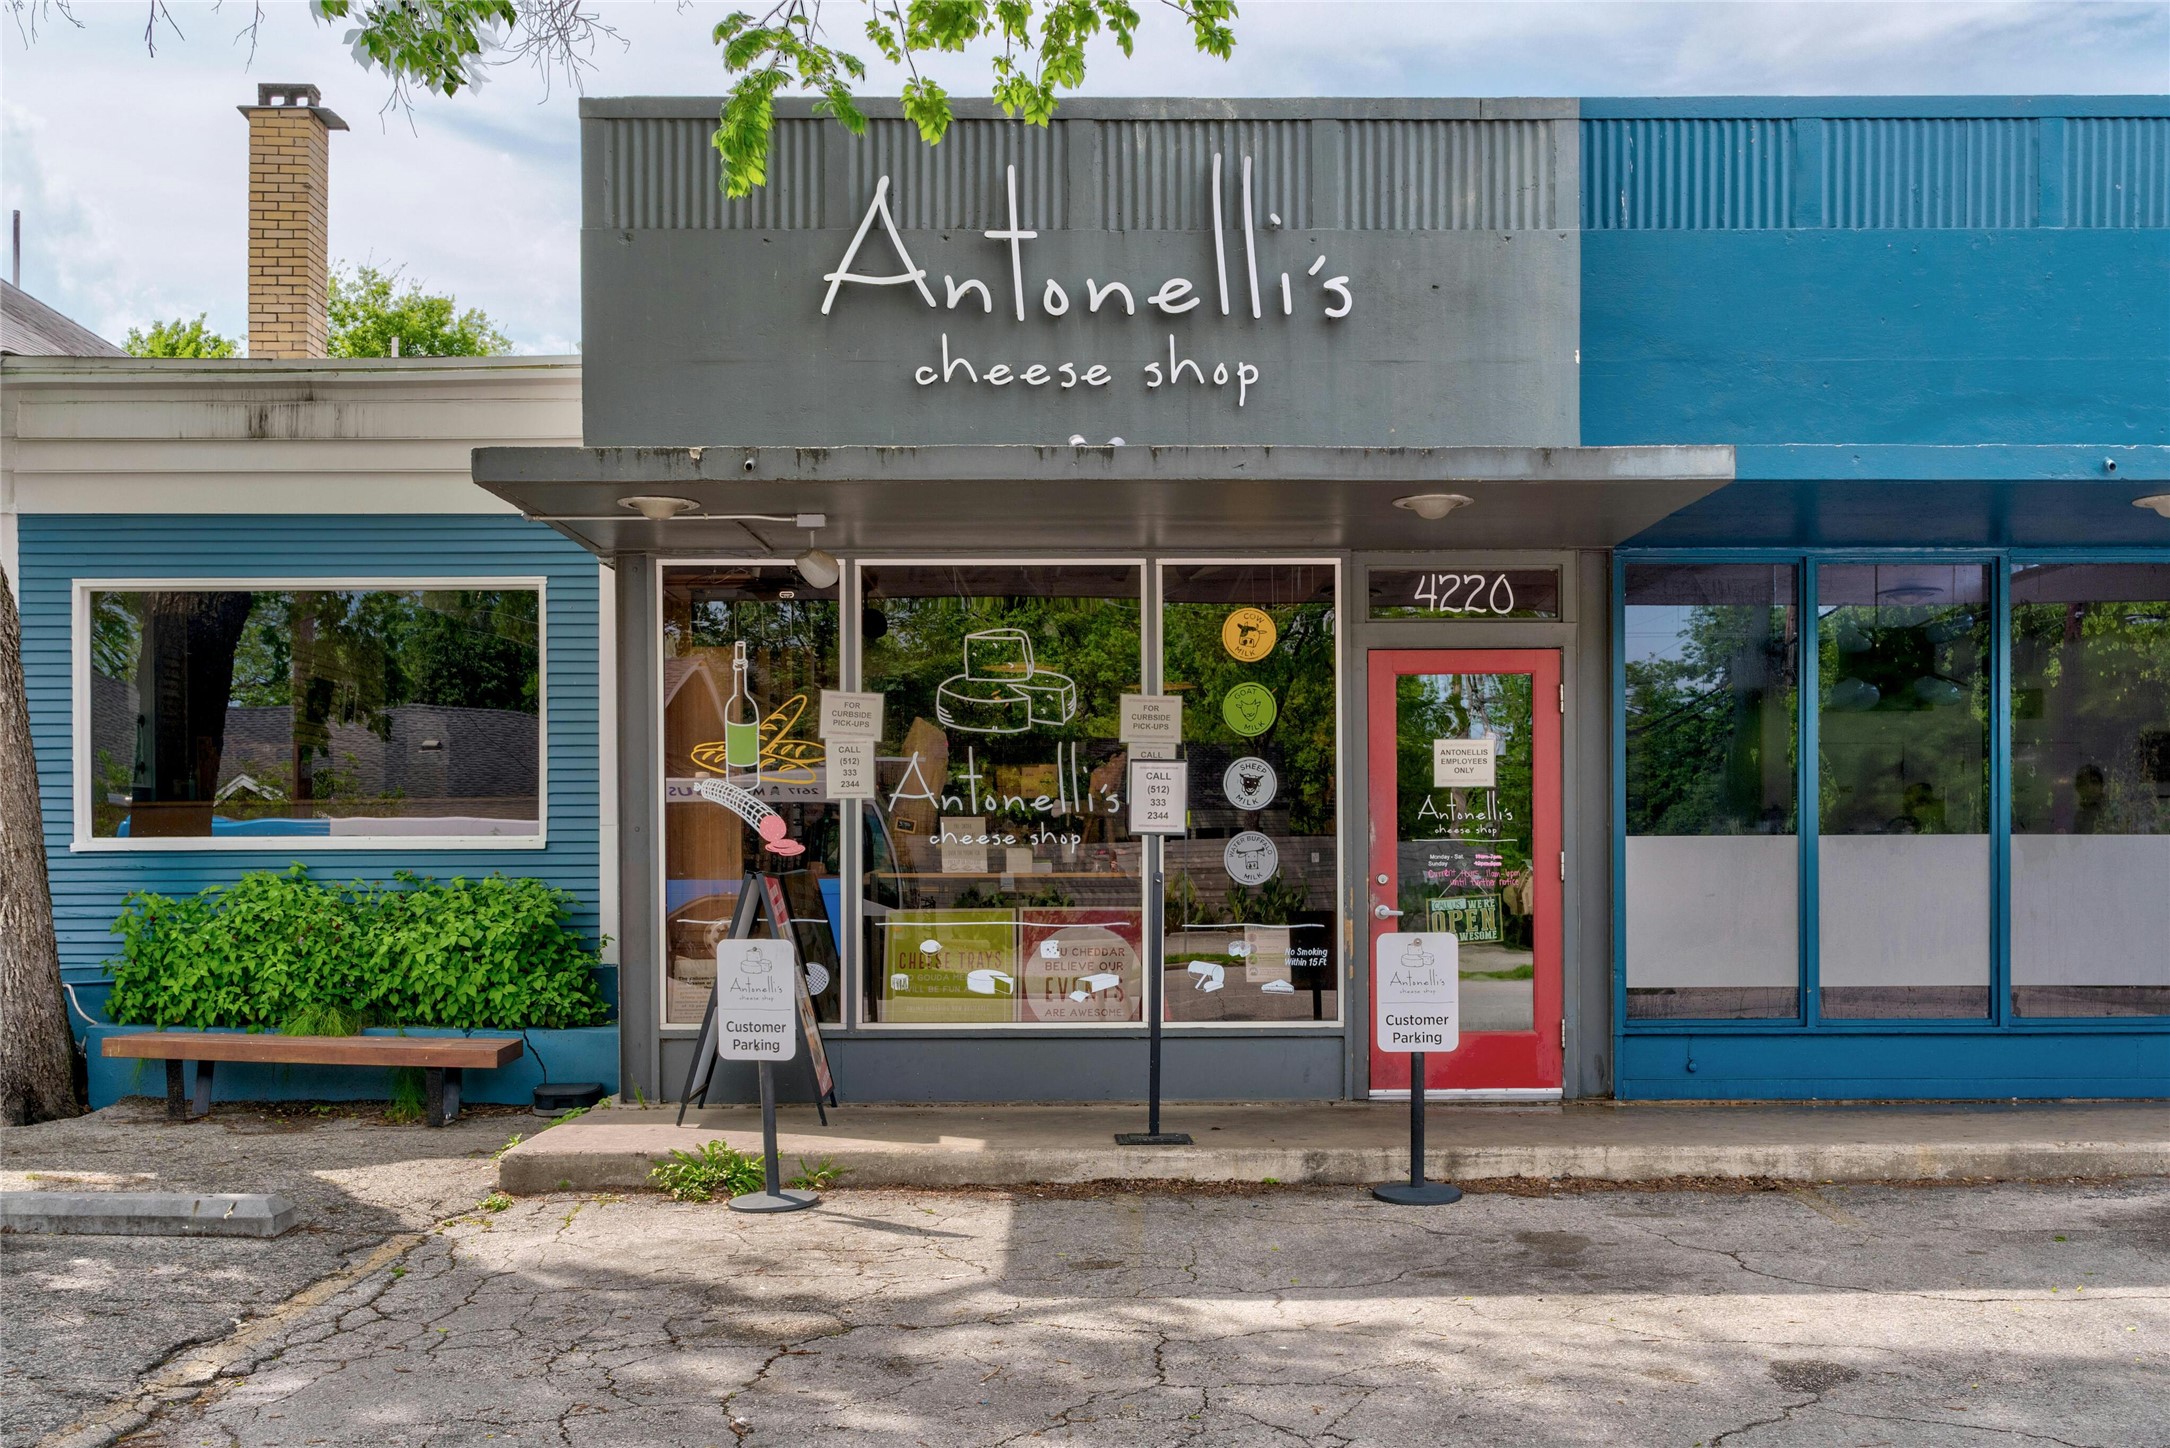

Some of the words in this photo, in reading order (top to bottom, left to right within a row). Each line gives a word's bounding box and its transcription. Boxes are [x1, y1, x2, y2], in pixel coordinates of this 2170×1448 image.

[821, 152, 1354, 322] Antonelli's
[914, 332, 1112, 389] cheese
[1144, 333, 1259, 408] shop
[1414, 573, 1515, 615] 4220
[1243, 613, 1265, 624] COW
[1235, 646, 1255, 657] MILK
[1234, 688, 1257, 700] GOAT
[832, 710, 872, 719] CURBSIDE
[1131, 713, 1171, 721] CURBSIDE
[833, 719, 870, 728] PICK-UPS
[1243, 720, 1265, 732] MILK
[1140, 751, 1163, 759] CALL
[1440, 748, 1489, 756] ANTONELLIS
[840, 758, 860, 767] (512)
[1440, 757, 1488, 765] EMPLOYEES
[1239, 763, 1267, 774] SHEEP
[1453, 766, 1474, 774] ONLY
[888, 741, 1120, 815] Antonelli's
[1146, 772, 1172, 781] CALL
[1147, 785, 1170, 795] (512)
[1150, 798, 1166, 807] 333
[1235, 794, 1259, 806] MILK
[1417, 791, 1513, 821] Antonelli's
[1147, 811, 1169, 820] 2344
[1434, 824, 1471, 834] cheese
[1476, 824, 1497, 837] shop
[929, 822, 1016, 846] cheese
[1031, 821, 1082, 854] shop
[1229, 837, 1246, 858] WATER
[1246, 836, 1273, 855] BUFFALO
[1243, 872, 1263, 881] MILK
[1431, 907, 1496, 933] OPEN
[1072, 947, 1125, 957] CHEDDAR
[1285, 948, 1295, 956] No
[1296, 947, 1328, 958] Smoking
[959, 951, 1002, 969] TRAYS
[1285, 958, 1307, 966] Within
[1309, 958, 1318, 966] 15
[1318, 958, 1327, 966] Ft
[1045, 961, 1094, 971] BELIEVE
[1099, 961, 1124, 971] OUR
[917, 973, 950, 982] GOUDA
[1389, 969, 1446, 987] Antonelli's
[729, 975, 783, 994] Antonelli's
[1045, 1009, 1065, 1017] ARE
[1385, 1014, 1449, 1026] Customer
[726, 1020, 787, 1034] Customer
[1392, 1032, 1442, 1045] Parking
[732, 1038, 780, 1053] Parking
